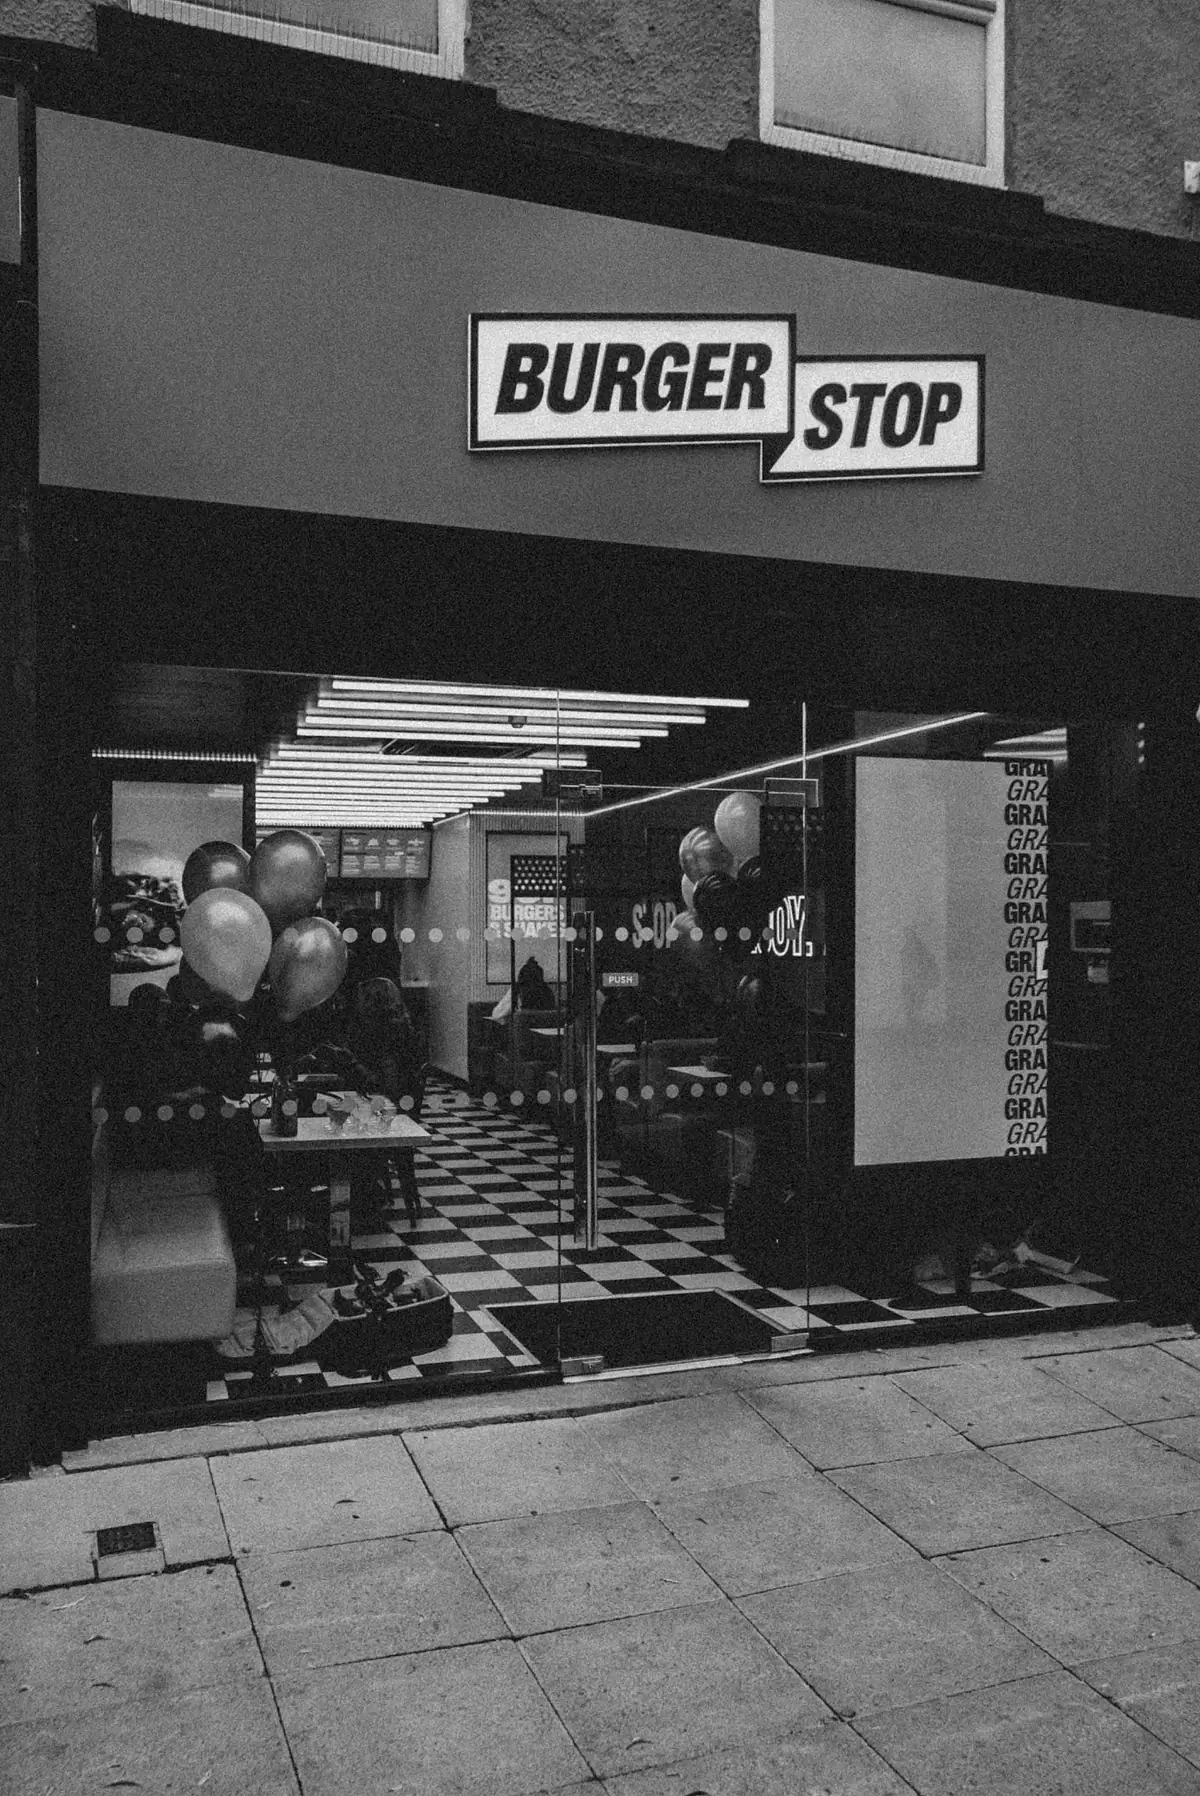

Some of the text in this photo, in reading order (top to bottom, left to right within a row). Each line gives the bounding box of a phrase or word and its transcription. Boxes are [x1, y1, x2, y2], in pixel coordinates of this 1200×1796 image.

[494, 341, 773, 415] BURGER
[803, 381, 963, 451] STOP
[490, 904, 566, 921] BURGERS
[632, 900, 677, 949] SOP
[608, 975, 633, 985] PUSH
